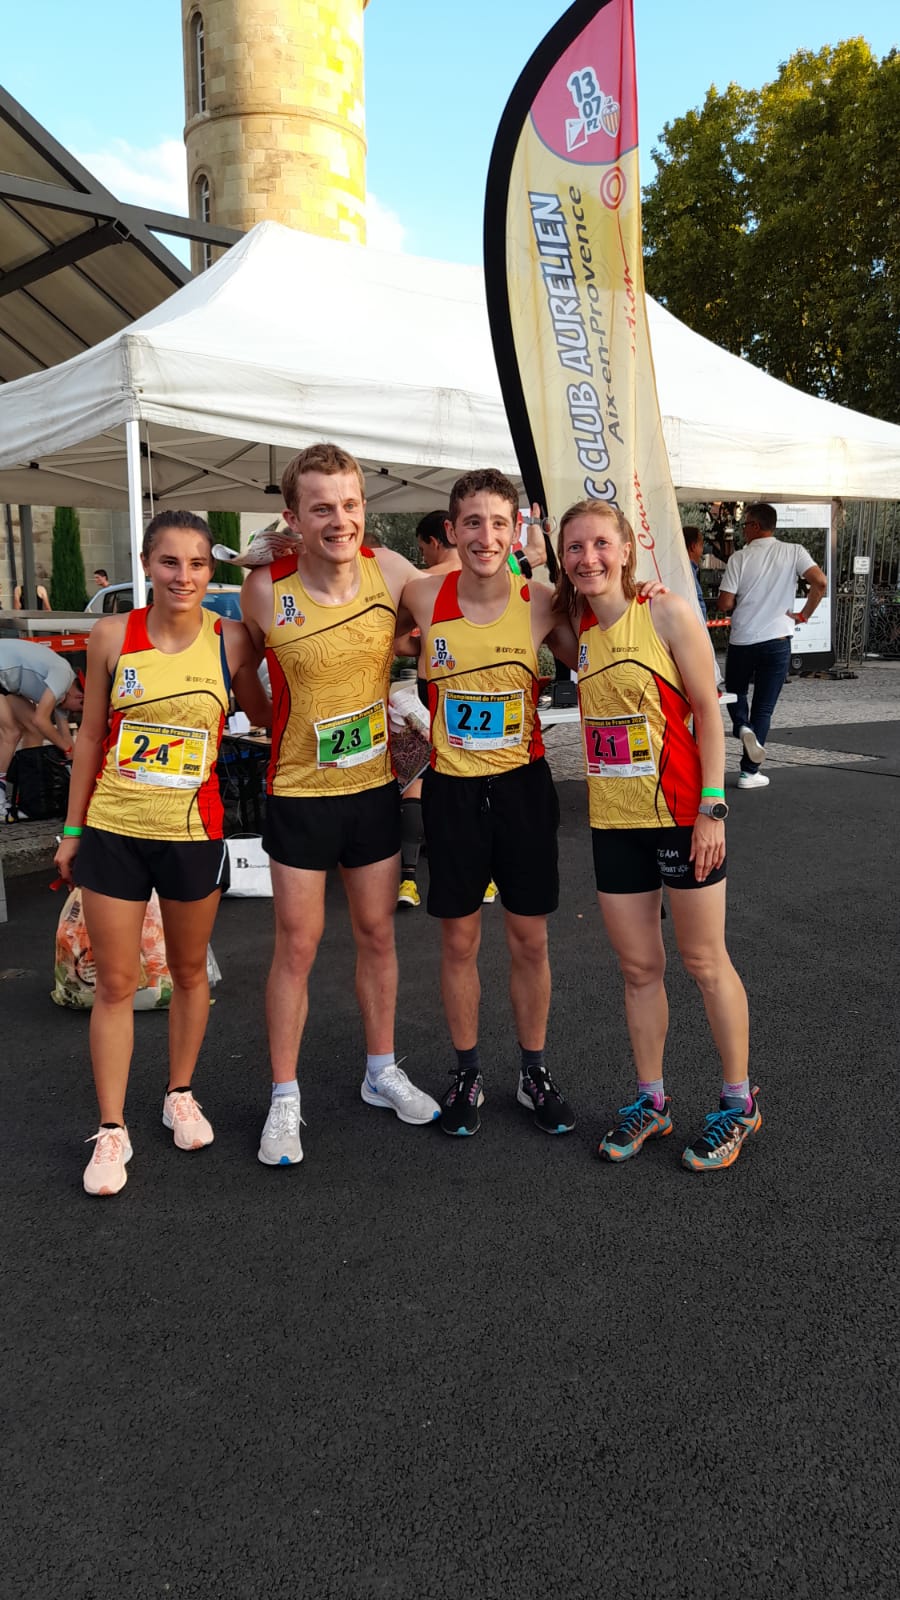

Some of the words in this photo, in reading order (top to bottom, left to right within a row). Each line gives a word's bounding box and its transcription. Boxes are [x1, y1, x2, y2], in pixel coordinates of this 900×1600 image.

[570, 71, 597, 104] 13
[582, 96, 601, 119] 07
[587, 117, 599, 132] PZ
[527, 190, 593, 378] AURELIEN
[569, 185, 625, 445] Aix-en-Provence
[566, 380, 611, 473] CLUB
[281, 595, 295, 609] 13
[285, 608, 297, 617] 07
[435, 639, 446, 651] 13
[438, 651, 448, 660] 07
[124, 669, 136, 681] 13
[126, 680, 136, 689] 07
[457, 703, 491, 731] 2.2
[131, 734, 170, 765] 2.4
[331, 727, 362, 755] 2.3
[591, 729, 617, 757] 2.1
